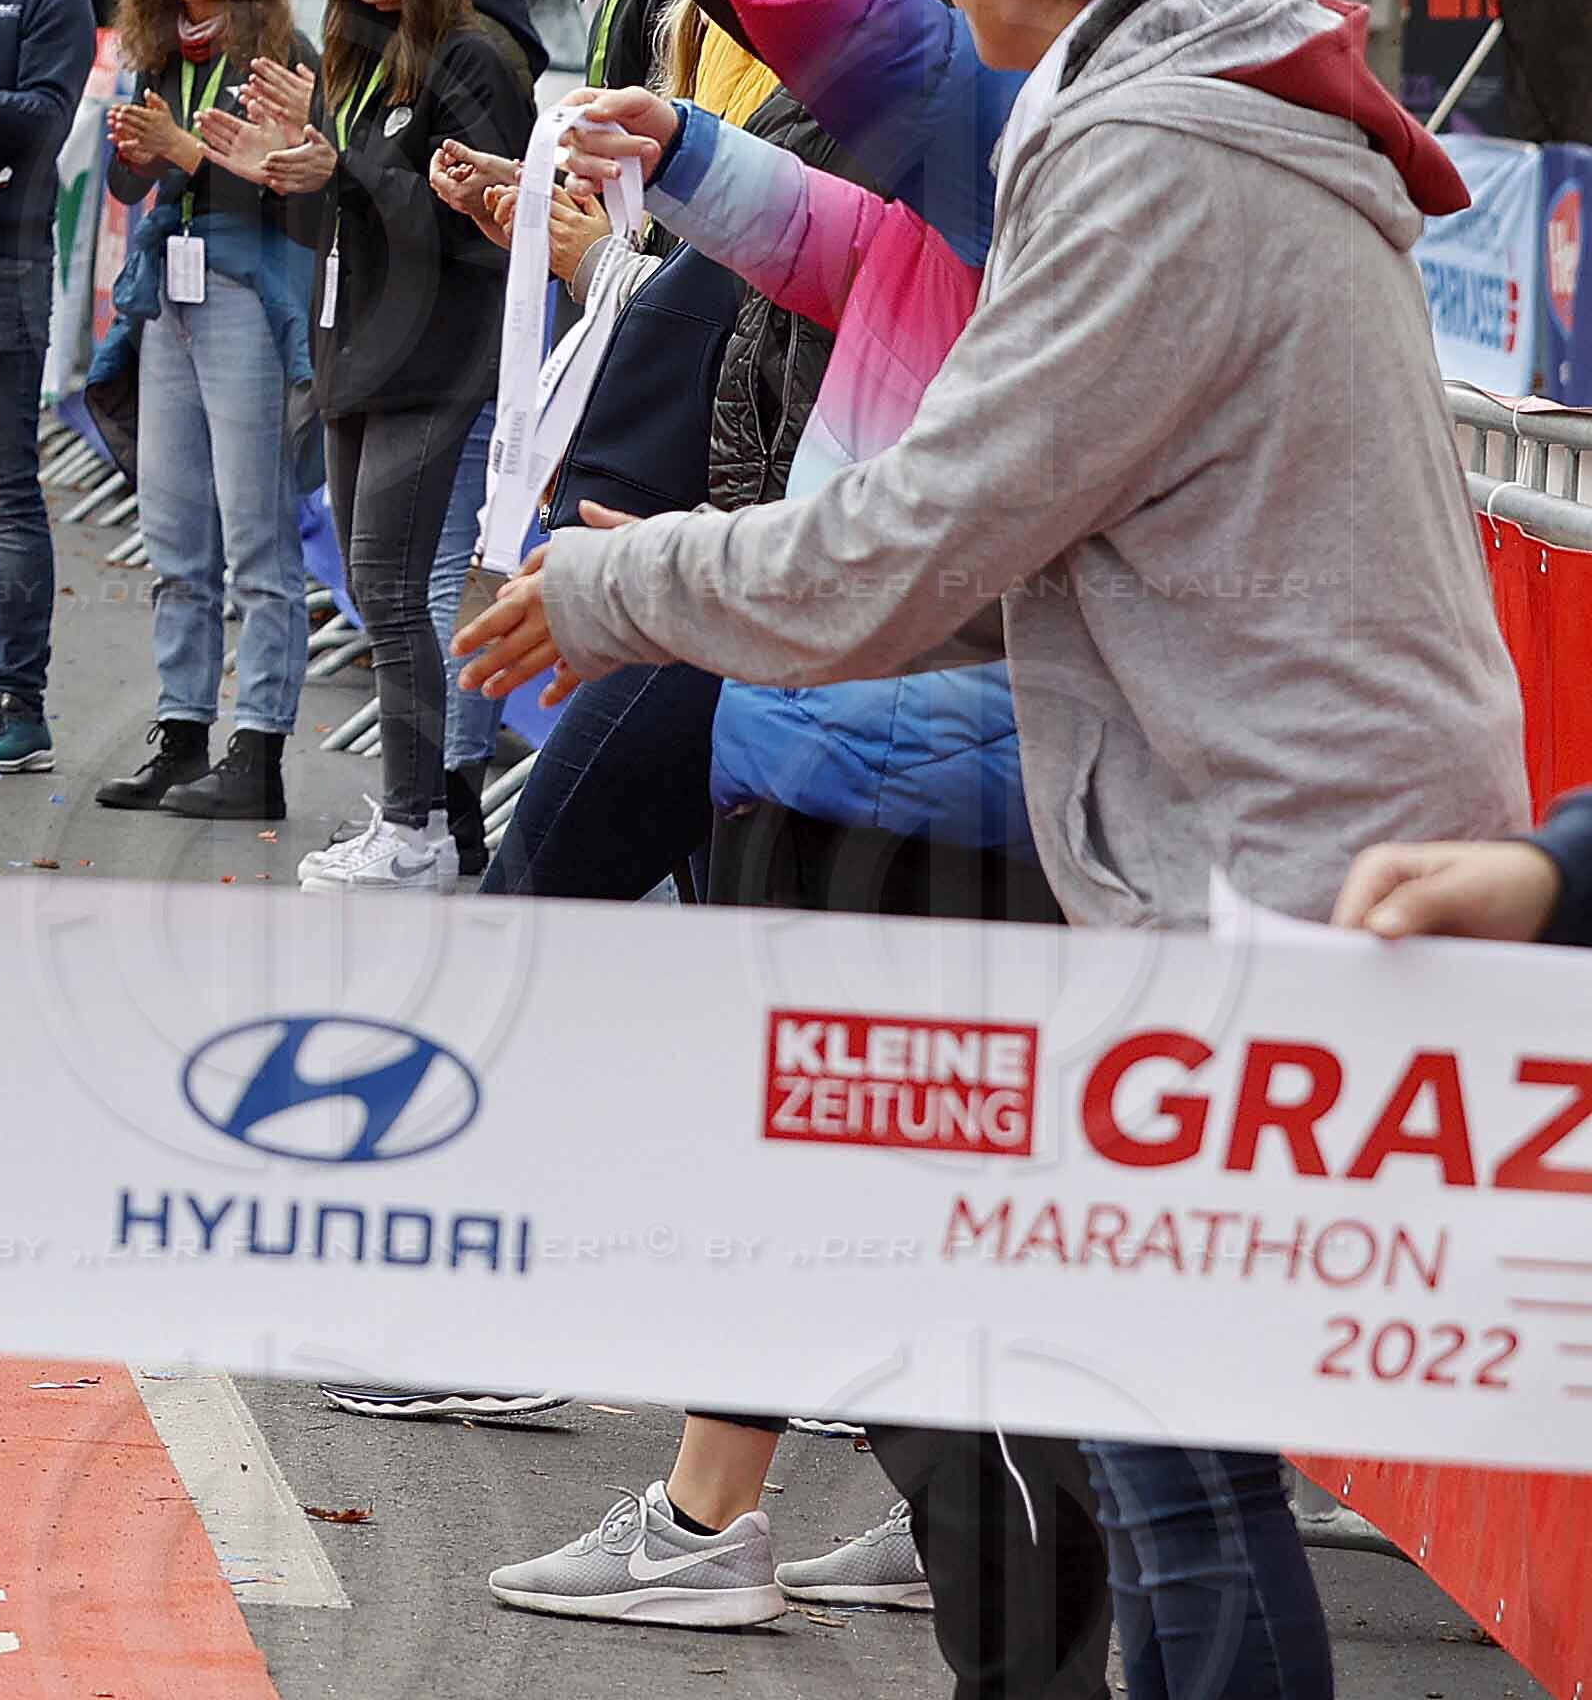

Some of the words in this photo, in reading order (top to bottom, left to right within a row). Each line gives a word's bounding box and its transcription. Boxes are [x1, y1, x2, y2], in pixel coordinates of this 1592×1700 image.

[773, 1019, 1030, 1088] KLEINE
[771, 1075, 1028, 1147] ZEITUNG
[1080, 1029, 1592, 1195] GRAZ
[116, 1188, 532, 1275] HYUNDAI
[940, 1196, 1450, 1291] MARATHON
[1314, 1316, 1520, 1393] 2022
